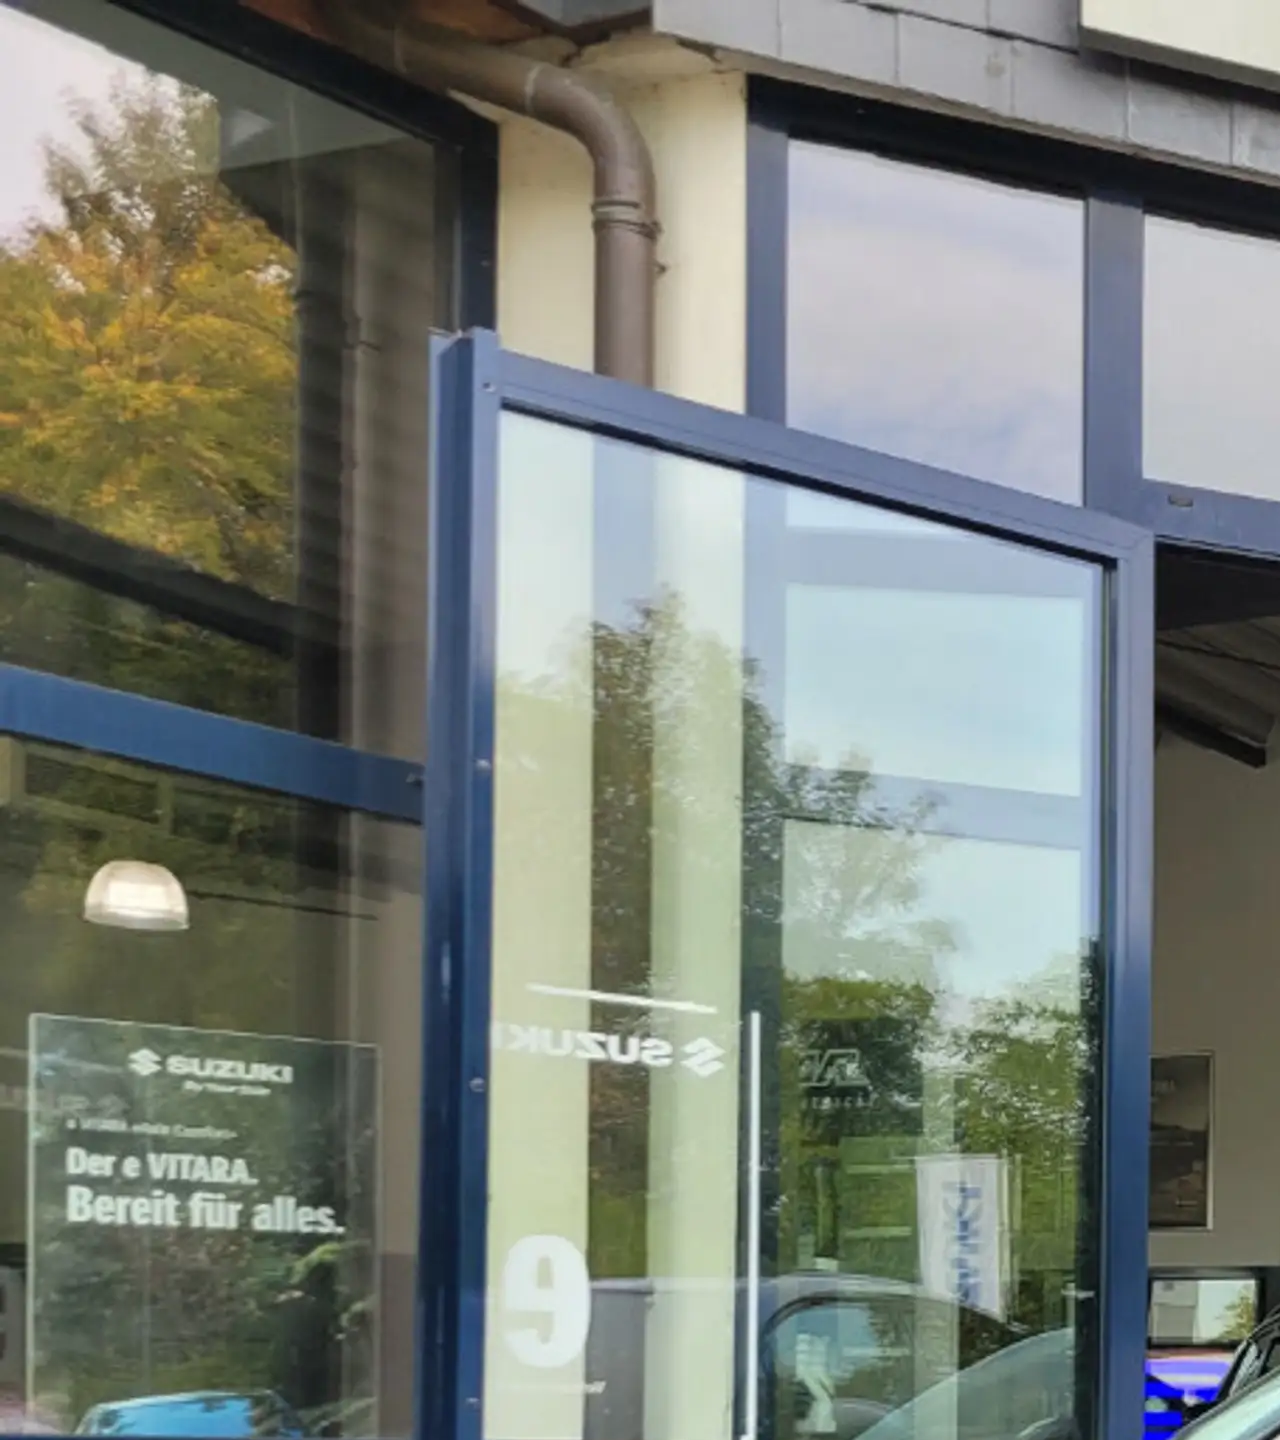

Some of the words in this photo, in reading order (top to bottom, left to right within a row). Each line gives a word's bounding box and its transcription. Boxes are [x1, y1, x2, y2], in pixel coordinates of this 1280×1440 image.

[165, 1054, 294, 1084] SUZUKI
[65, 1146, 117, 1177] Der
[121, 1154, 142, 1178] e
[147, 1152, 260, 1185] VITARA.
[66, 1184, 181, 1227] Bereit
[187, 1190, 243, 1230] für
[252, 1195, 345, 1234] alles.
